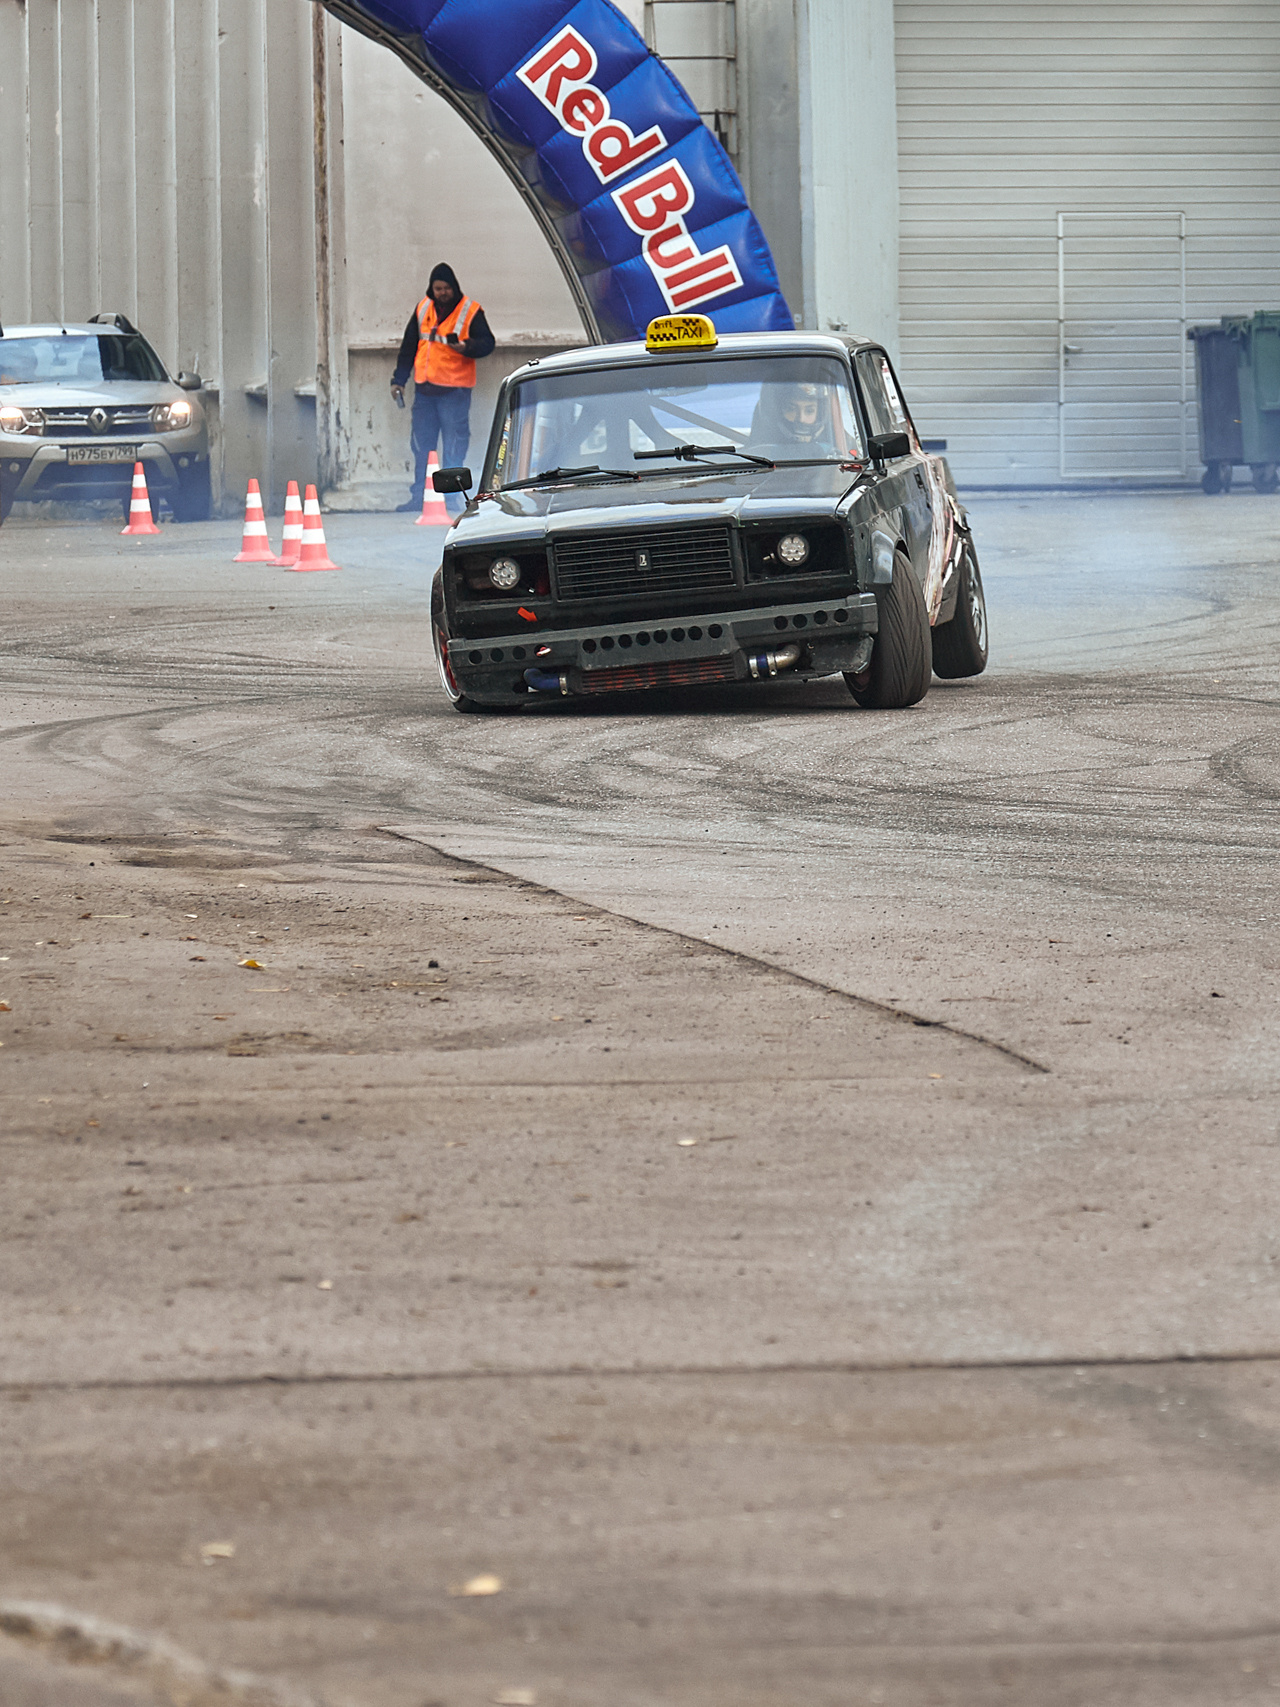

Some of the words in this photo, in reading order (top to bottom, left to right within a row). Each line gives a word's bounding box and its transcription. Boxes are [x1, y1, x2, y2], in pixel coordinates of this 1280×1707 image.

[519, 27, 665, 182] Red
[614, 161, 740, 310] Bull
[654, 320, 673, 329] Drift
[674, 326, 702, 340] TAXI
